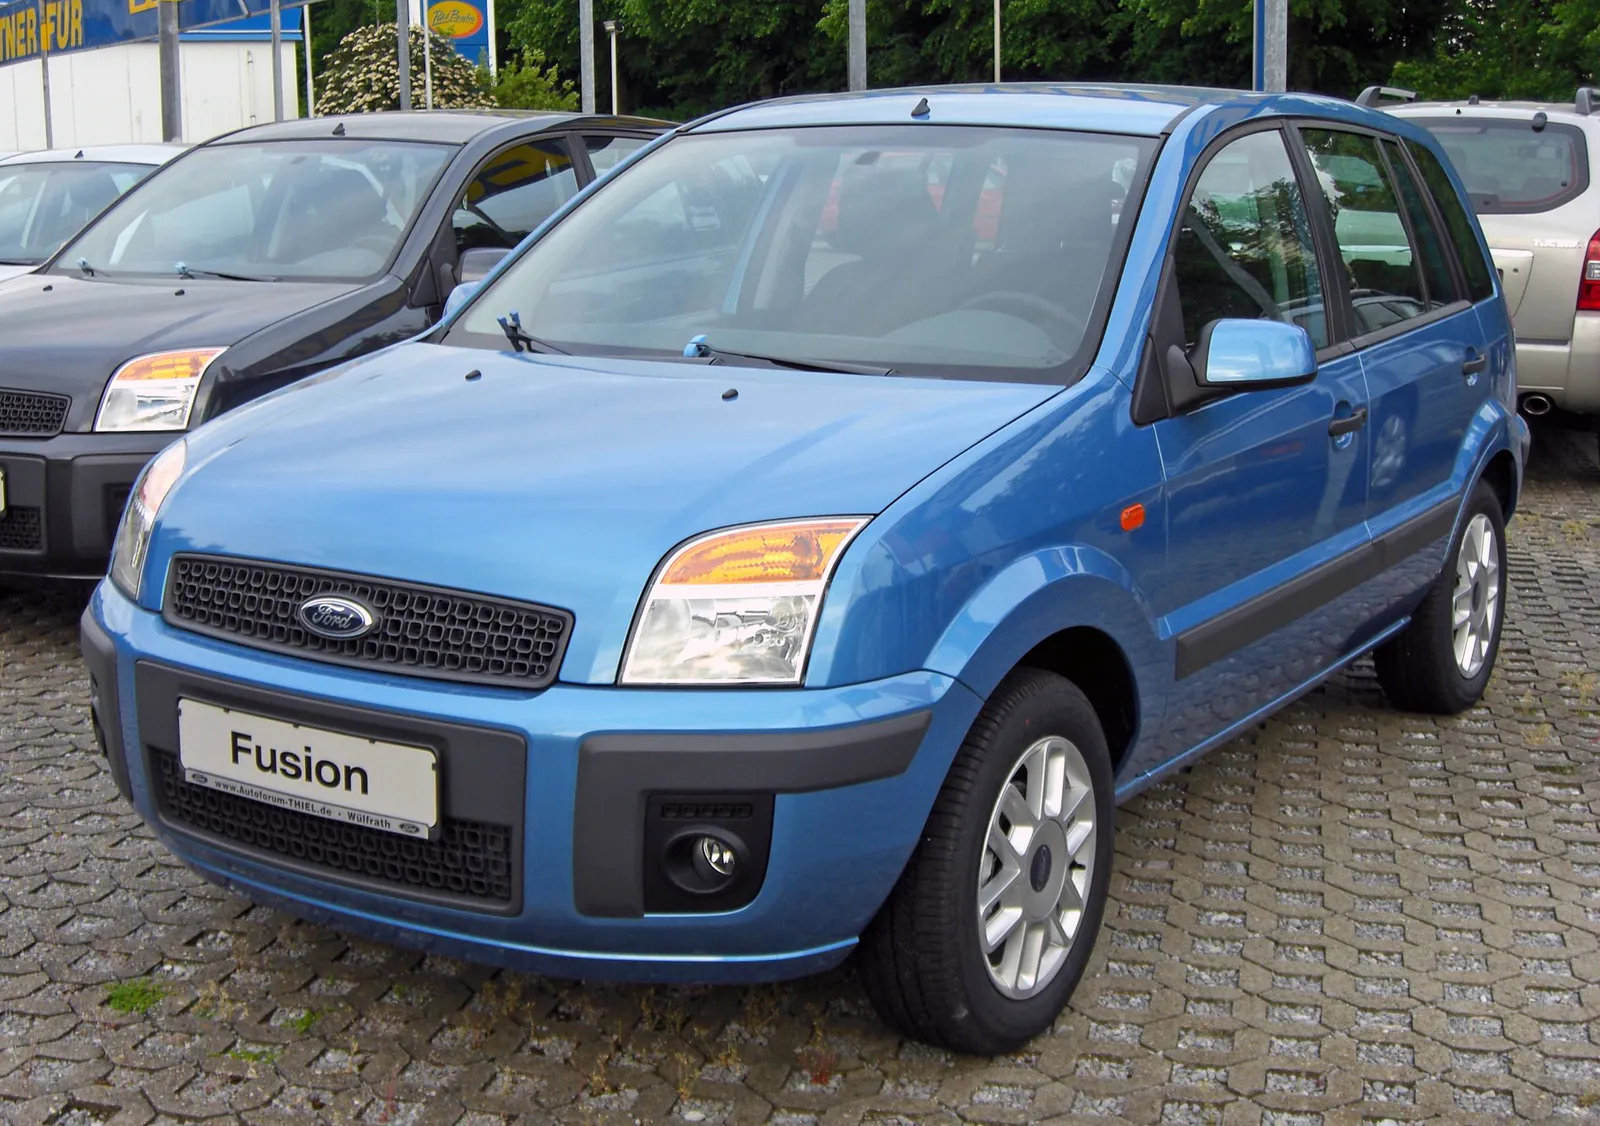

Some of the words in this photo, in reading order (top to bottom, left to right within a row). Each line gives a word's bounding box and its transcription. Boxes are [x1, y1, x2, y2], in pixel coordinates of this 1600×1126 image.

[312, 603, 354, 629] Ford
[230, 730, 369, 796] Fusion
[347, 811, 391, 830] Wülfrath
